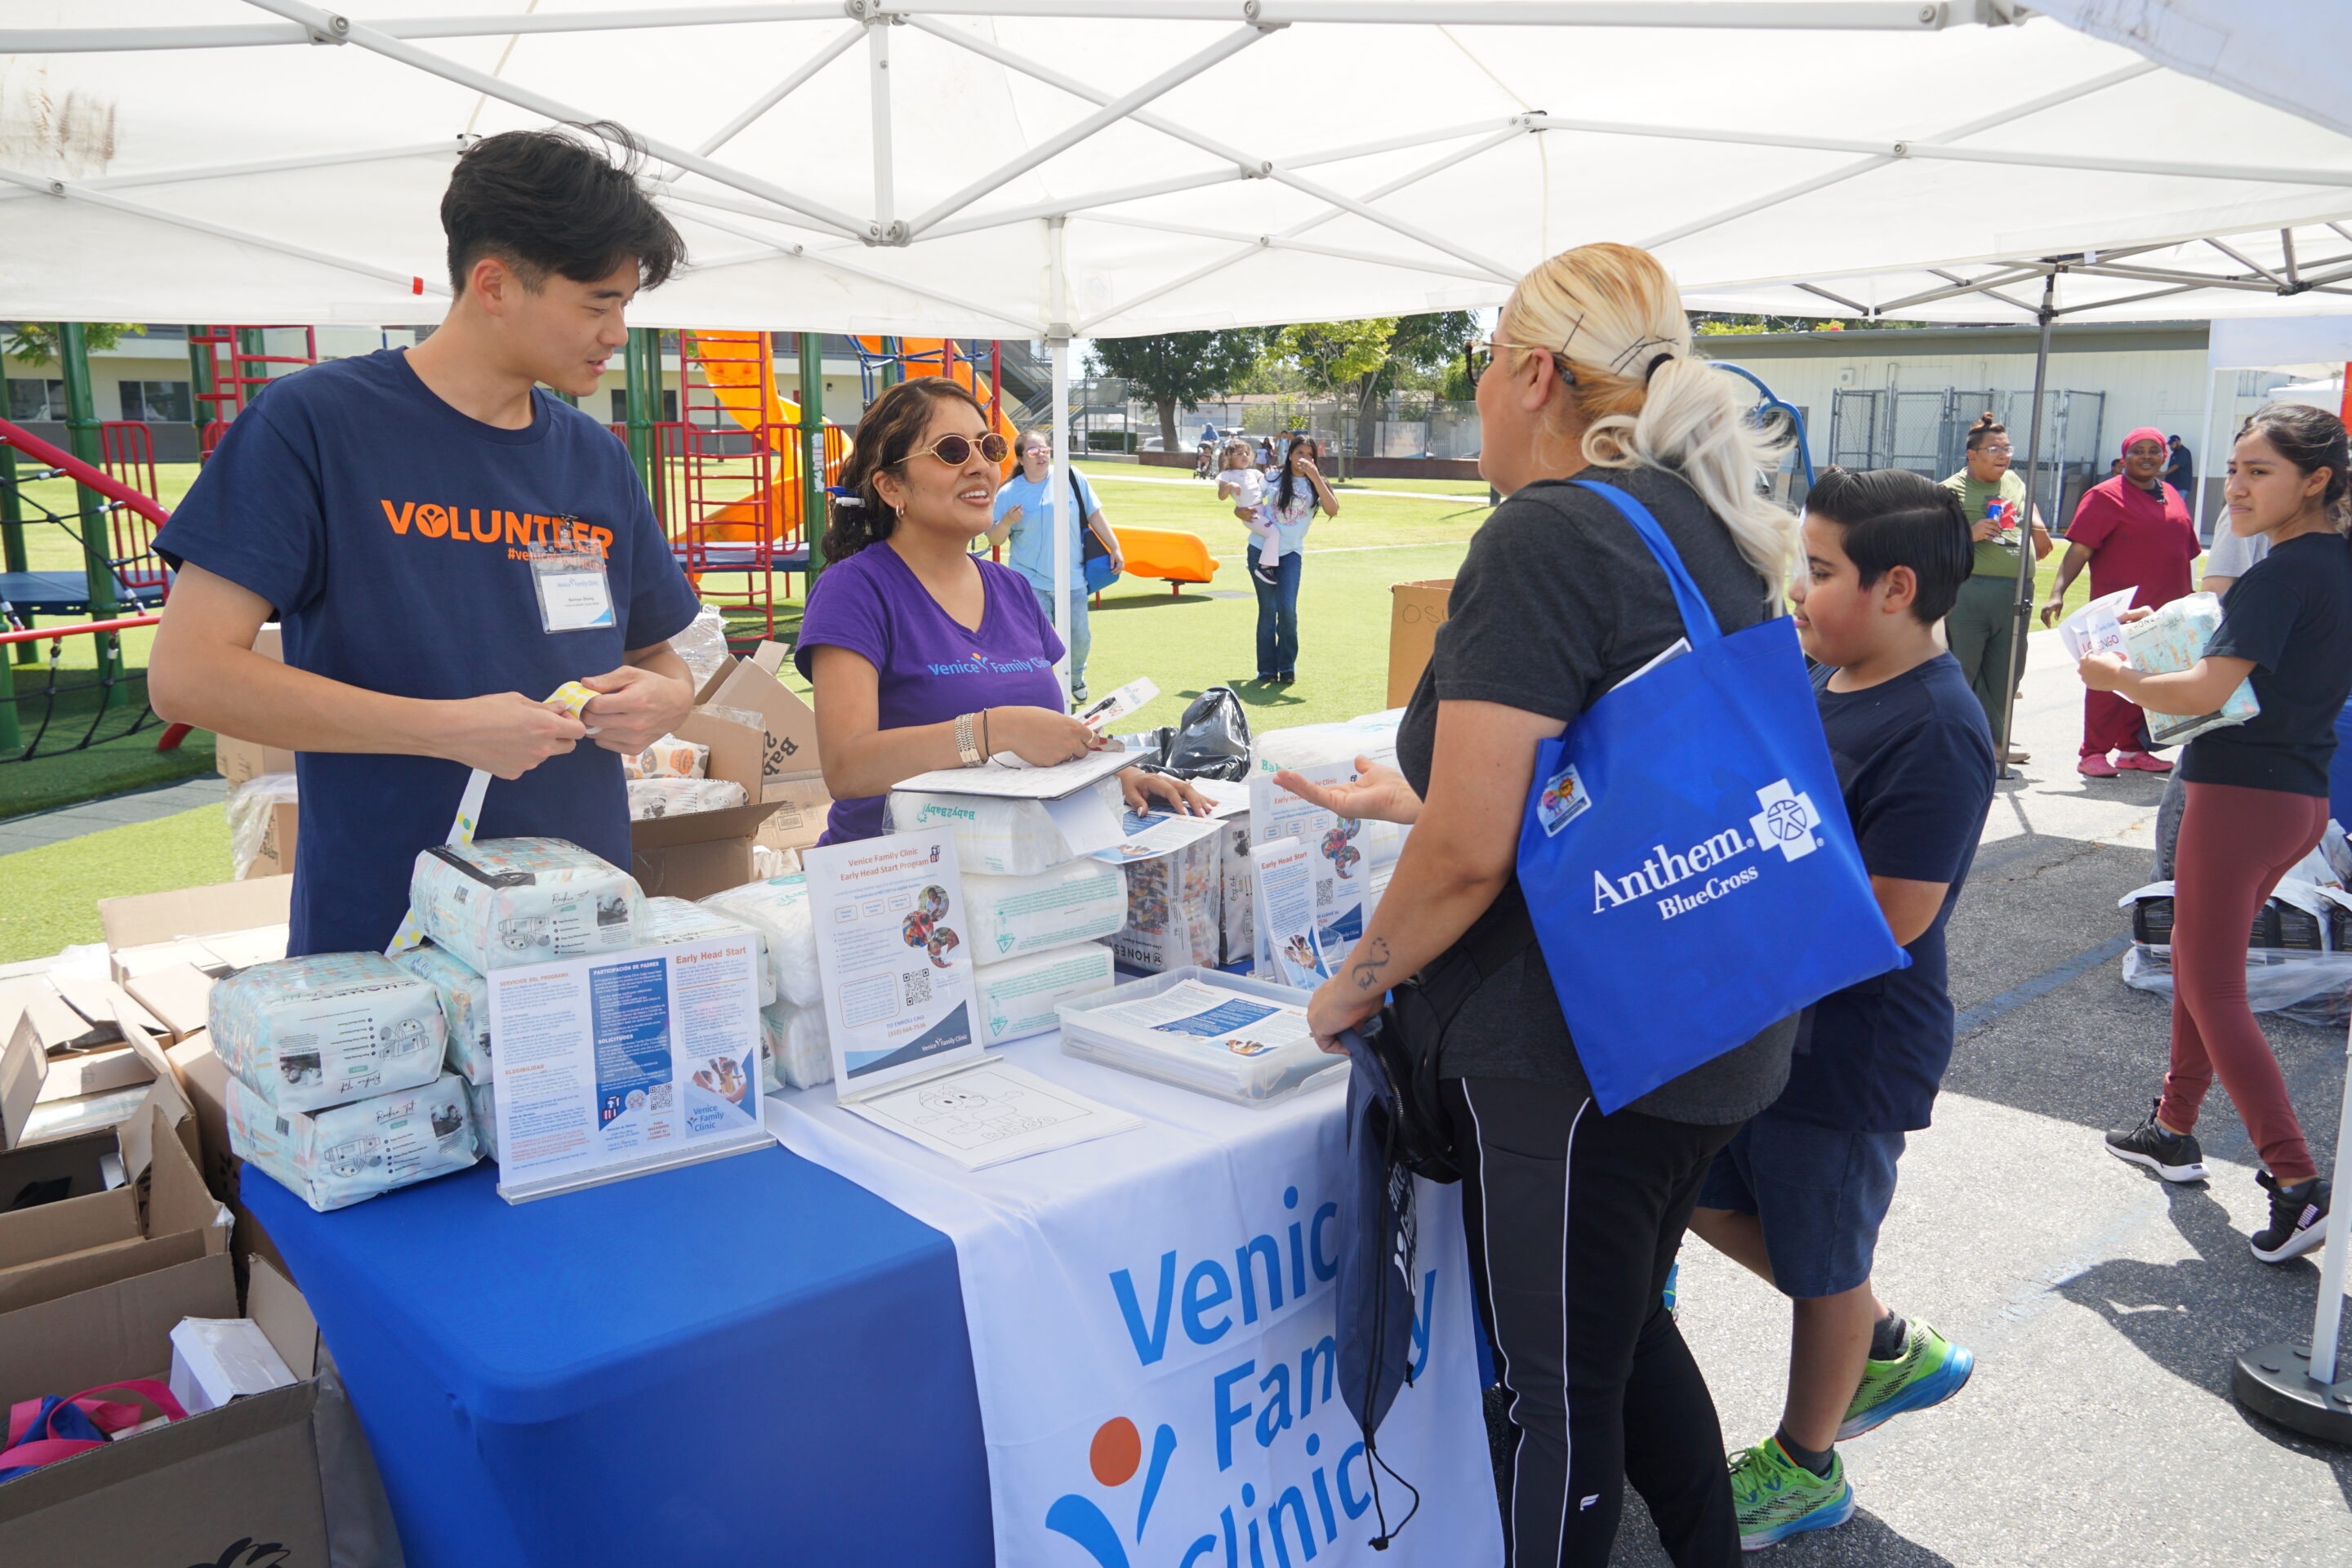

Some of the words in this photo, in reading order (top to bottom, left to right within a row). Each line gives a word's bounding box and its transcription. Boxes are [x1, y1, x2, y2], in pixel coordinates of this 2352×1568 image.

[381, 500, 614, 559] VOLUNTEER
[927, 659, 980, 676] Venice
[990, 660, 1034, 674] Family
[1030, 657, 1052, 668] Clini
[848, 856, 874, 866] Venice
[875, 852, 898, 862] Family
[899, 848, 919, 858] Clinic
[1261, 860, 1276, 870] Early
[1278, 856, 1293, 865] Head
[1294, 852, 1307, 860] Start
[840, 872, 859, 881] Early
[860, 868, 880, 877] Head
[880, 863, 898, 872] Start
[899, 858, 929, 870] Program
[1592, 826, 1748, 914] Anthem
[1655, 864, 1759, 920] BlueCross
[675, 955, 698, 964] Early
[701, 950, 723, 960] Head
[725, 947, 746, 957] Start
[1111, 942, 1152, 964] HONES
[593, 964, 632, 976] PARTICIPACIÓN
[640, 960, 660, 969] PADRES
[499, 978, 528, 987] SERVICIOS
[541, 972, 569, 981] PROGRAMA
[597, 1034, 634, 1045] SOLICITUDES
[921, 1043, 937, 1051] Venice
[940, 1038, 956, 1046] Family
[956, 1033, 968, 1042] Clinic
[505, 1064, 545, 1076] ELEGIBILIDAD
[693, 1105, 718, 1115] Venice
[700, 1111, 724, 1122] Family
[694, 1122, 716, 1132] Clinic
[1109, 1185, 1340, 1366] Venic
